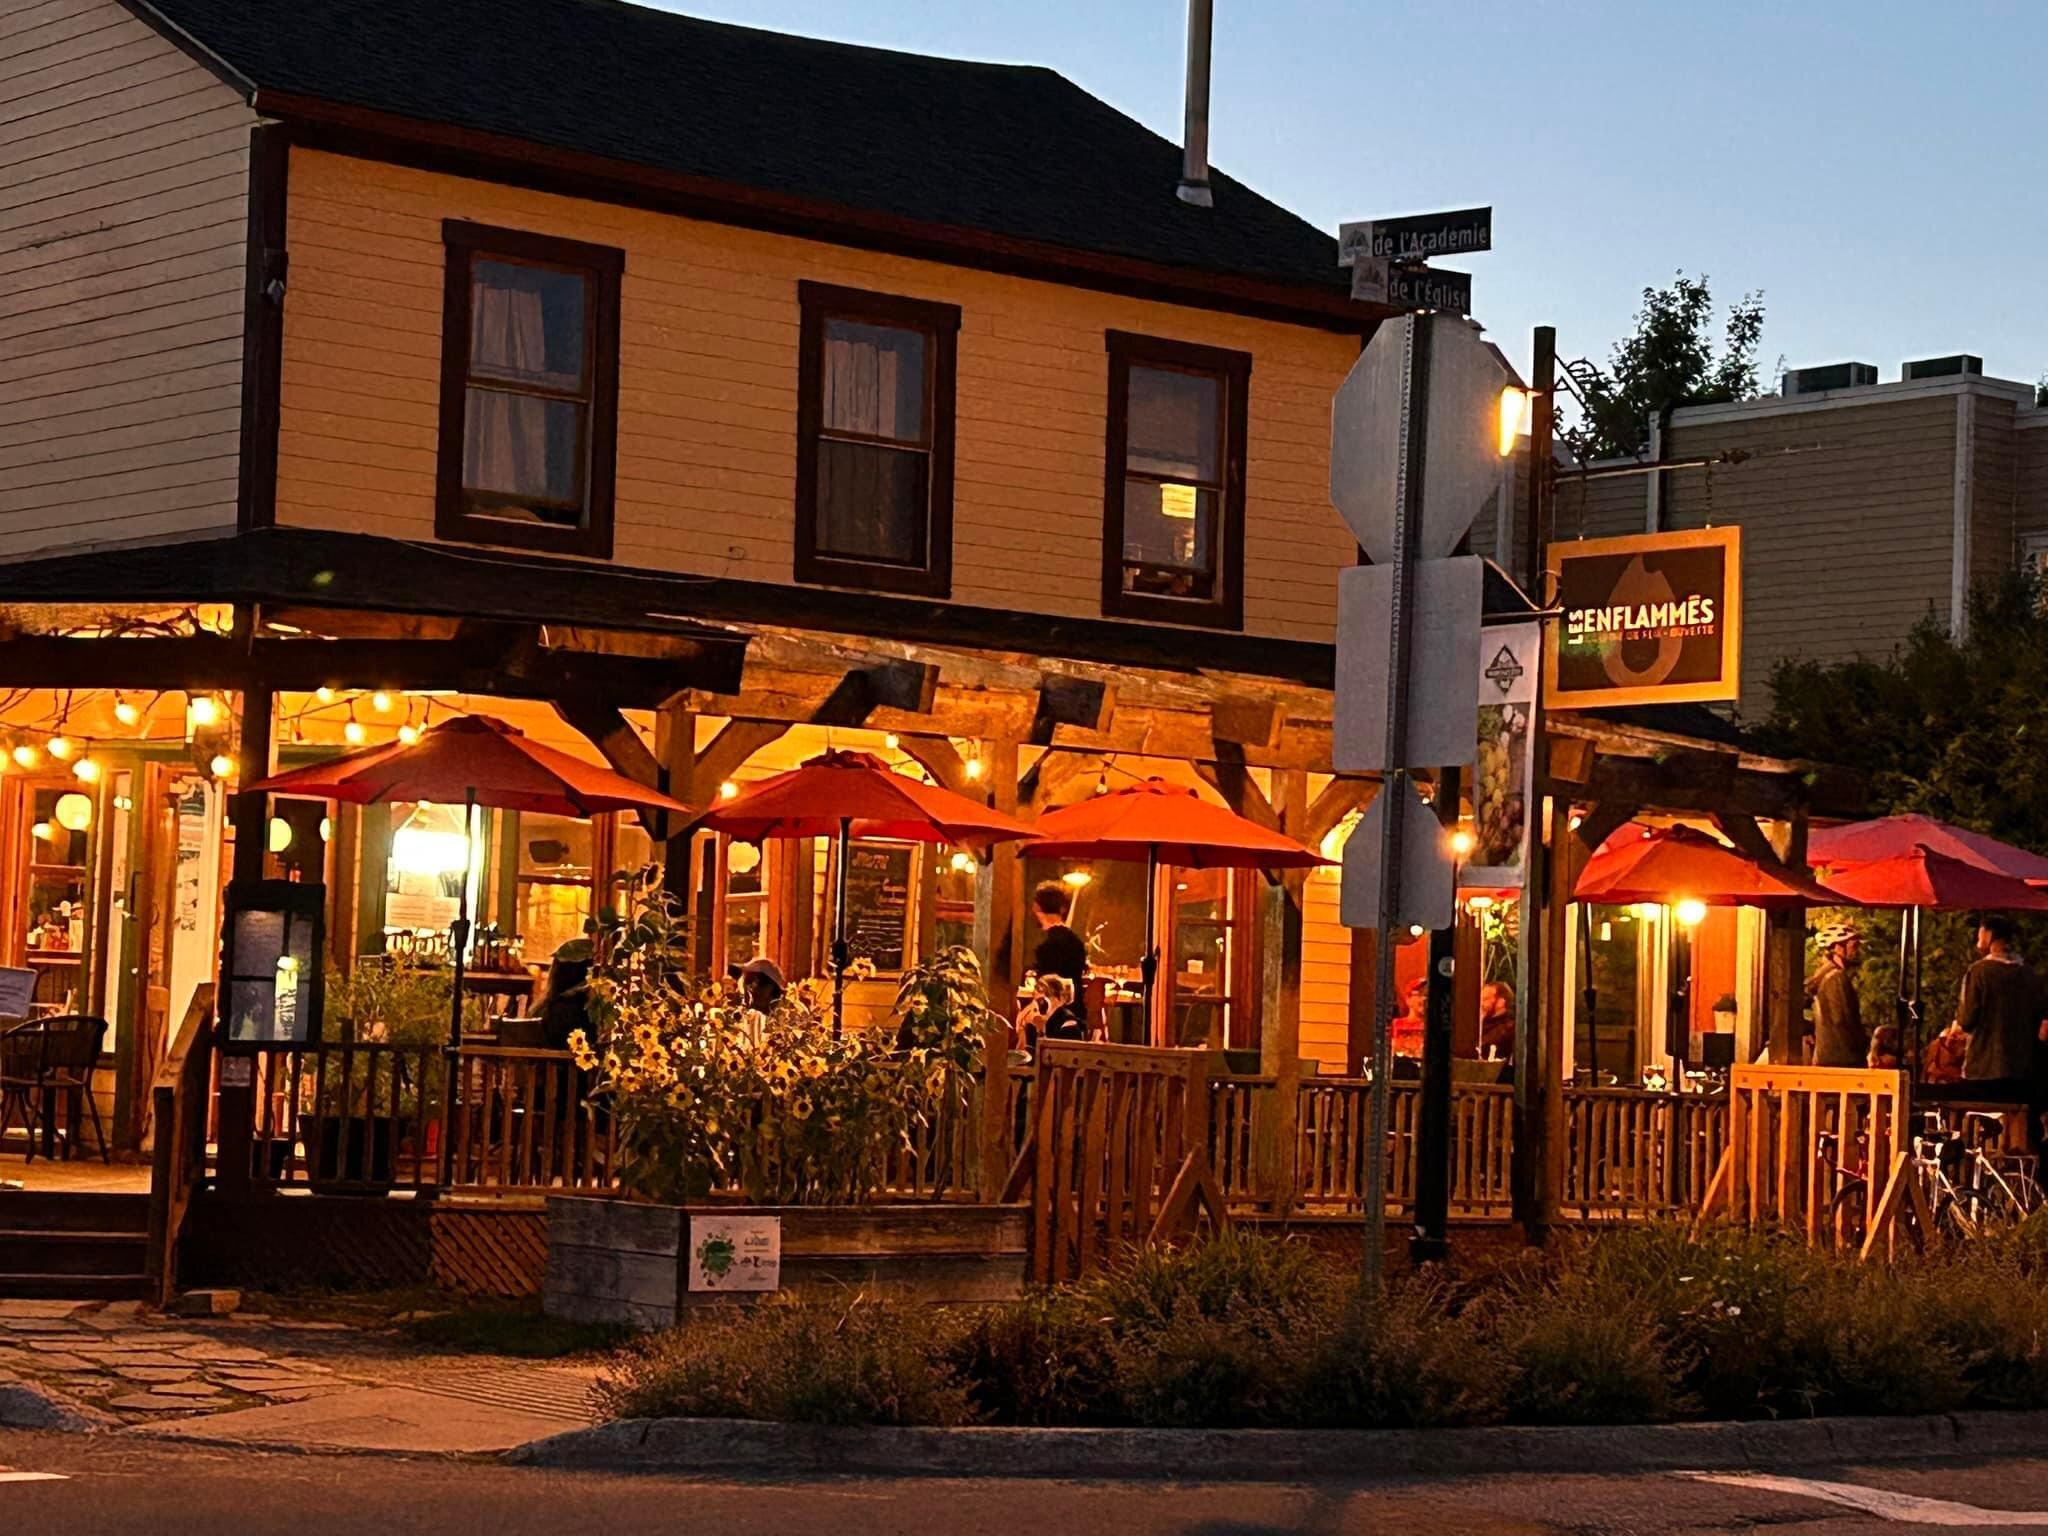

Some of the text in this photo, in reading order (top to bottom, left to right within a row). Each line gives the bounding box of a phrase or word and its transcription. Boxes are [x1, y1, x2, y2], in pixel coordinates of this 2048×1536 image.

[1374, 234, 1393, 256] de
[1389, 277, 1408, 300] de
[1568, 594, 1714, 645] LES ENFLAMMÉS
